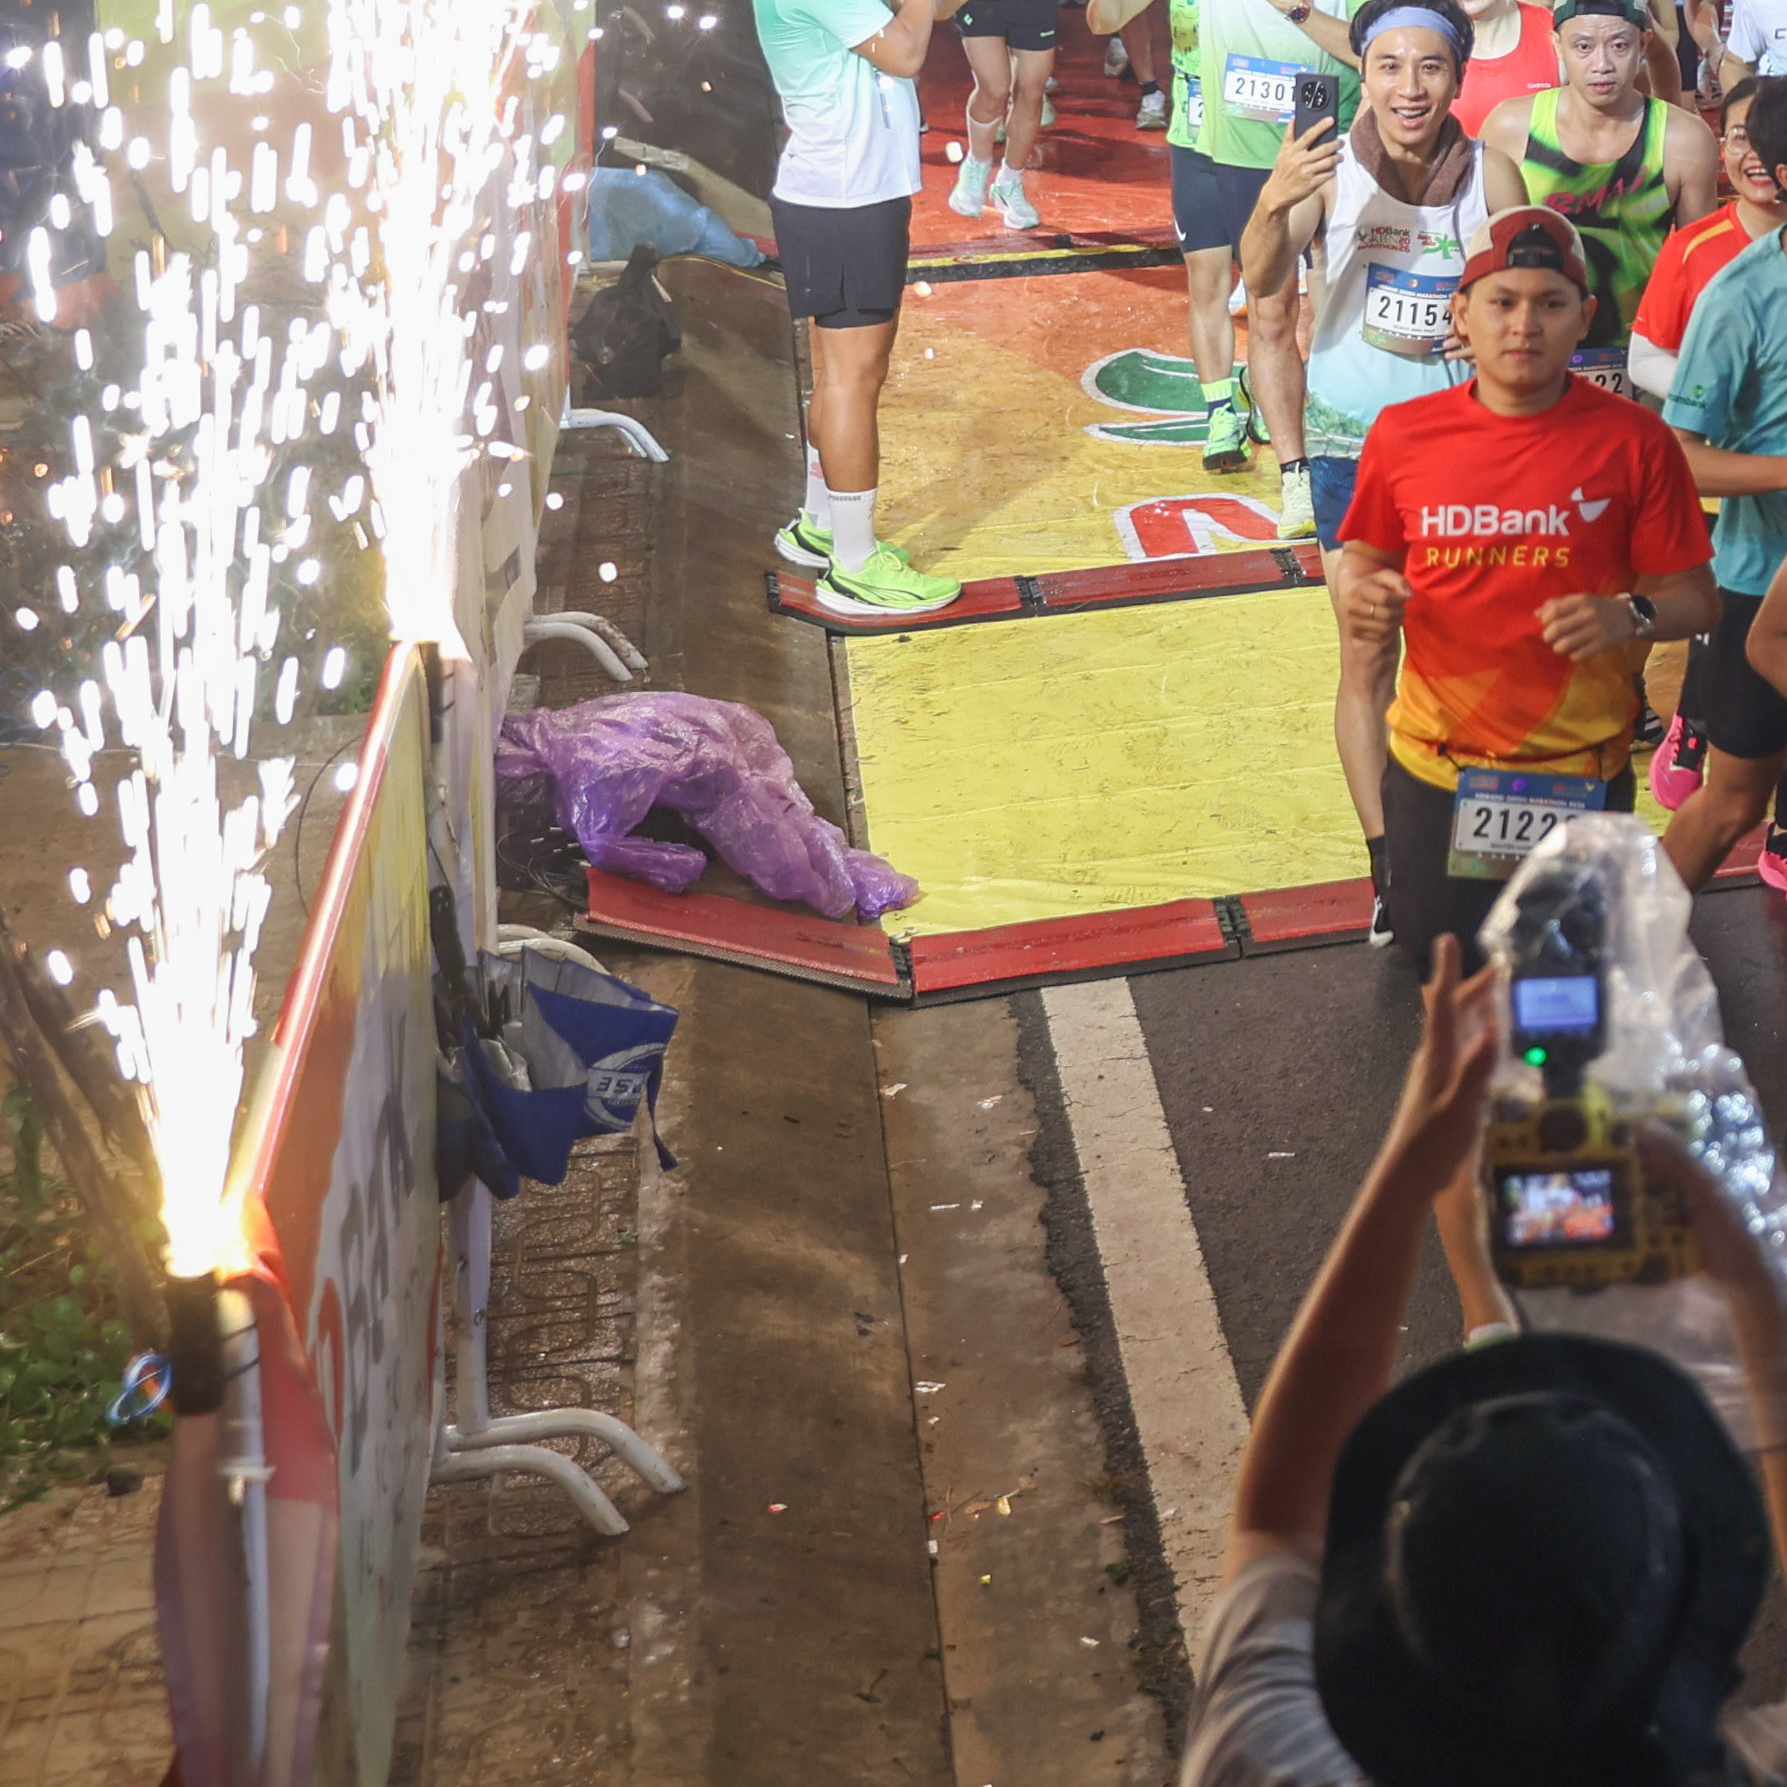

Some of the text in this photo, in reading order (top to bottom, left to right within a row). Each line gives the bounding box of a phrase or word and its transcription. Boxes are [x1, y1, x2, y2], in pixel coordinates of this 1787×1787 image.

[1378, 295, 1453, 327] 21154
[1419, 503, 1570, 539] HDBank
[1425, 545, 1570, 569] RUNNERS
[1472, 806, 1579, 843] 2122
